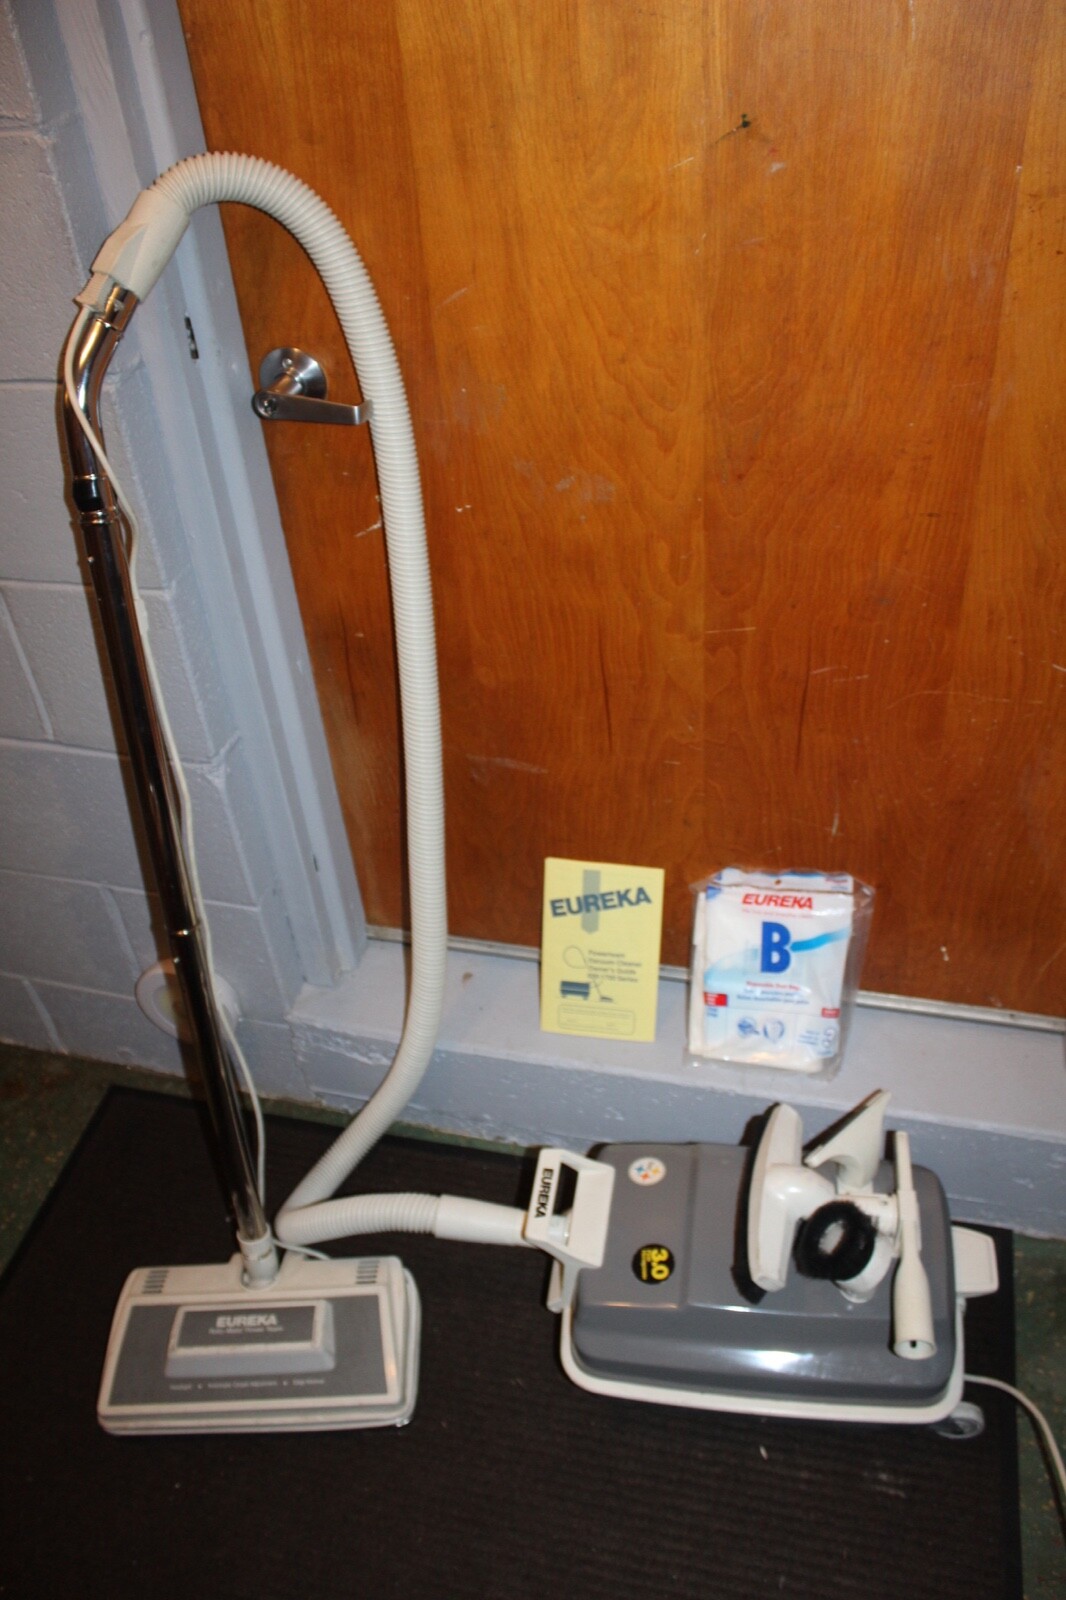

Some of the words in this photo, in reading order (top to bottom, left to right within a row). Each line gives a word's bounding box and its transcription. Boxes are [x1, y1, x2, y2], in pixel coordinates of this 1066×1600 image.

[550, 887, 652, 917] EUREKA
[742, 893, 813, 910] EUREKA
[761, 921, 791, 974] B
[534, 1168, 554, 1218] EUREKA
[216, 1313, 278, 1329] EUREKA
